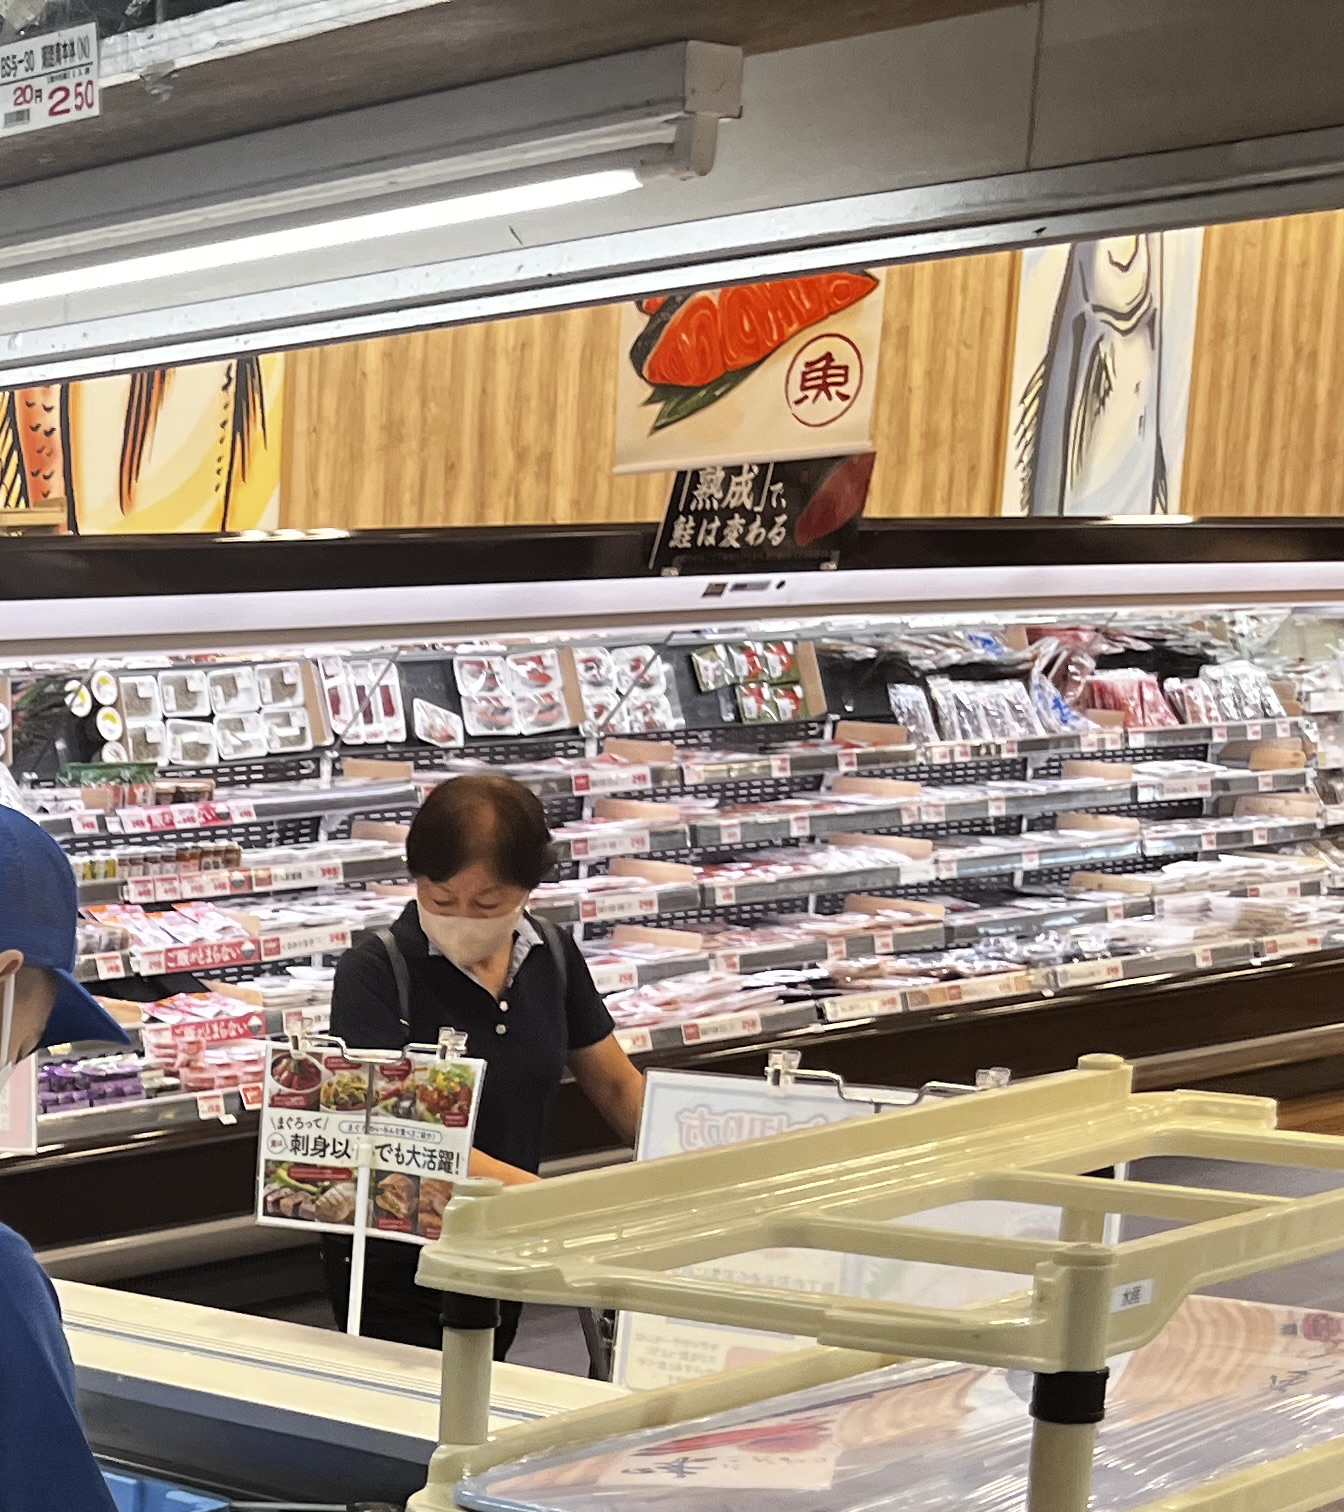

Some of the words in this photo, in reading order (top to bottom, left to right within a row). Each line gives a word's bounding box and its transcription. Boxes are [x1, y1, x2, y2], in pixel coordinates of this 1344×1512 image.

[793, 351, 850, 406] 魚
[668, 513, 788, 549] 鮭は変わる
[277, 1116, 322, 1130] まぐろって
[289, 1134, 461, 1174] 刺身以でも大活躍!
